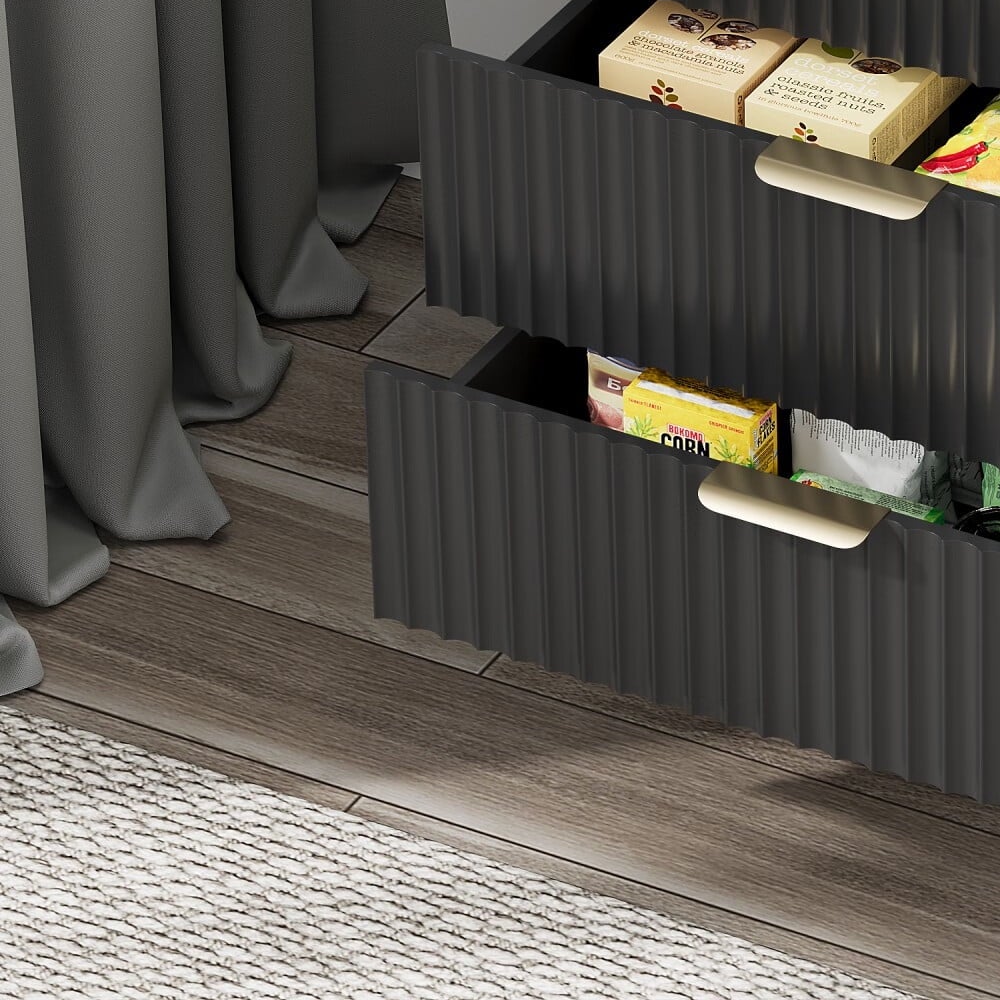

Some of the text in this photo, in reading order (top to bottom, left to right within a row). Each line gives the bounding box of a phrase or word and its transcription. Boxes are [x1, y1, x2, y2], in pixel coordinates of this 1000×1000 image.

[628, 39, 641, 47] &
[641, 43, 714, 67] macadamia
[715, 63, 745, 75] nuts
[633, 35, 695, 55] chocolate
[695, 52, 745, 70] granola
[777, 75, 834, 95] classic
[784, 67, 881, 98] cereals
[794, 56, 877, 85] dorset
[763, 88, 829, 110] & seeds
[771, 82, 876, 115] roasted nuts
[661, 432, 710, 458] CORN
[668, 424, 704, 442] BOKOMO
